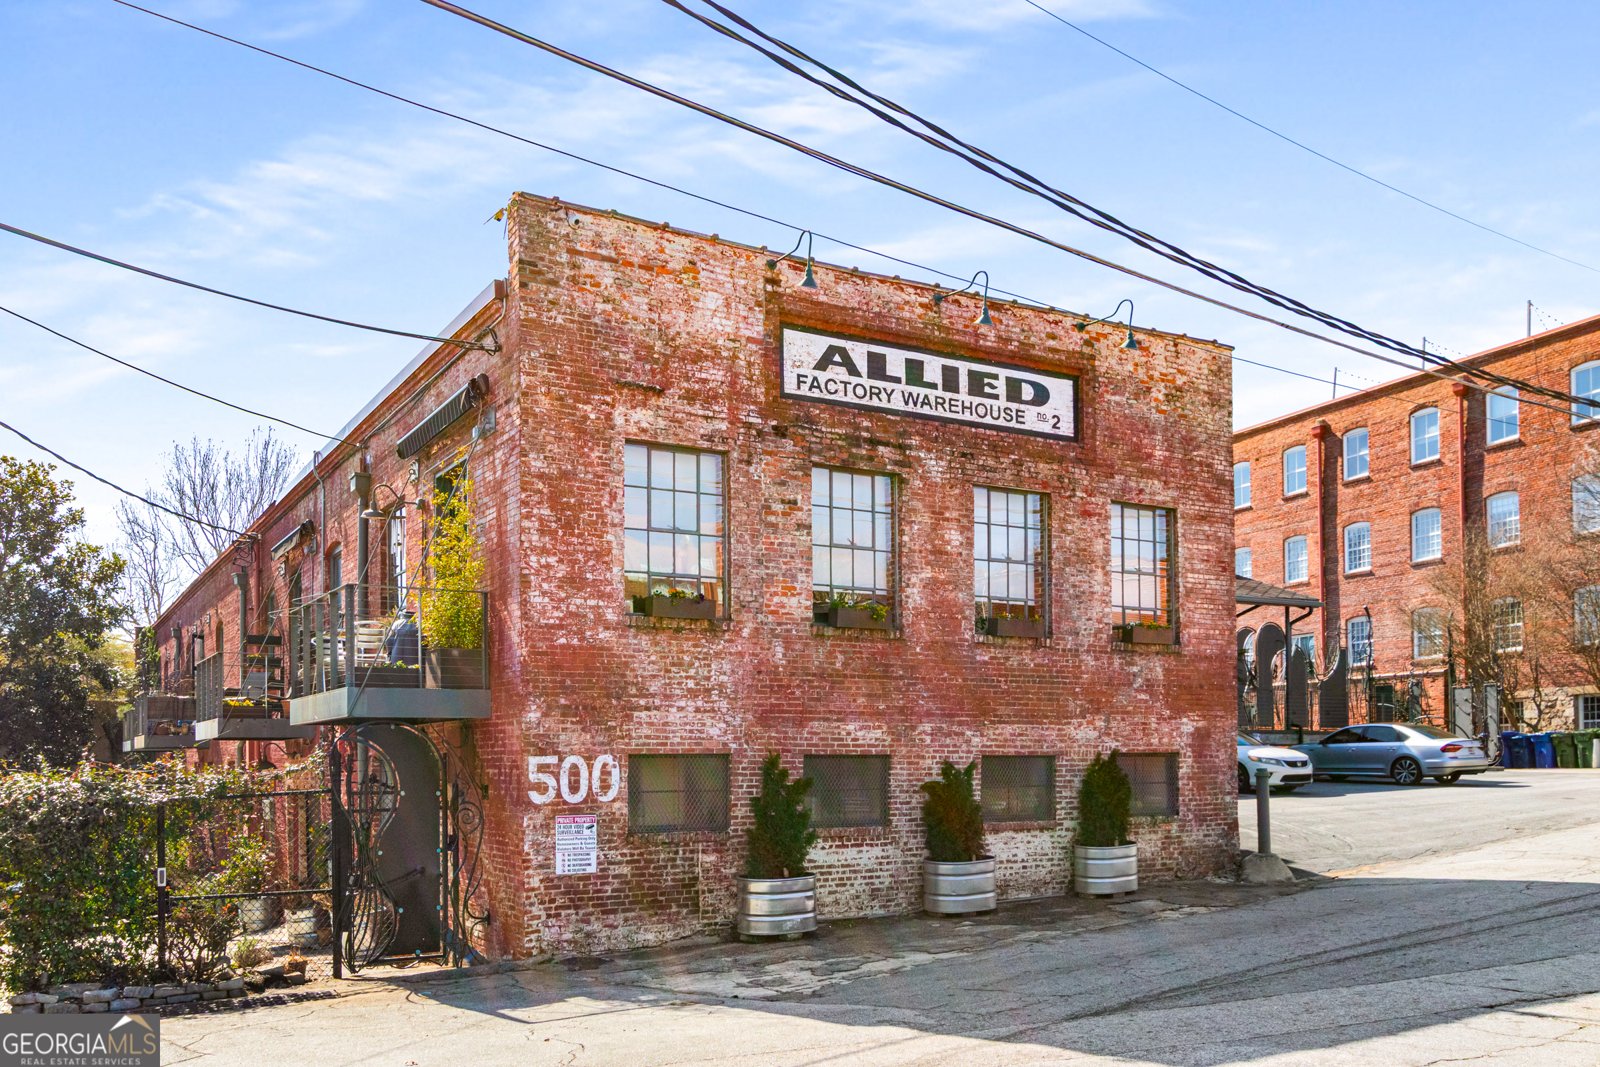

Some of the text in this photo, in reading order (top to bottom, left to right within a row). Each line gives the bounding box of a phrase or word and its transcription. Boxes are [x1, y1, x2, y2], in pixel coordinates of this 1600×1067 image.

[796, 373, 895, 403] FACTORY
[901, 390, 1026, 424] WAREHOUSE
[1051, 414, 1061, 429] 2
[812, 344, 1050, 407] ALLIED
[528, 754, 620, 805] 500
